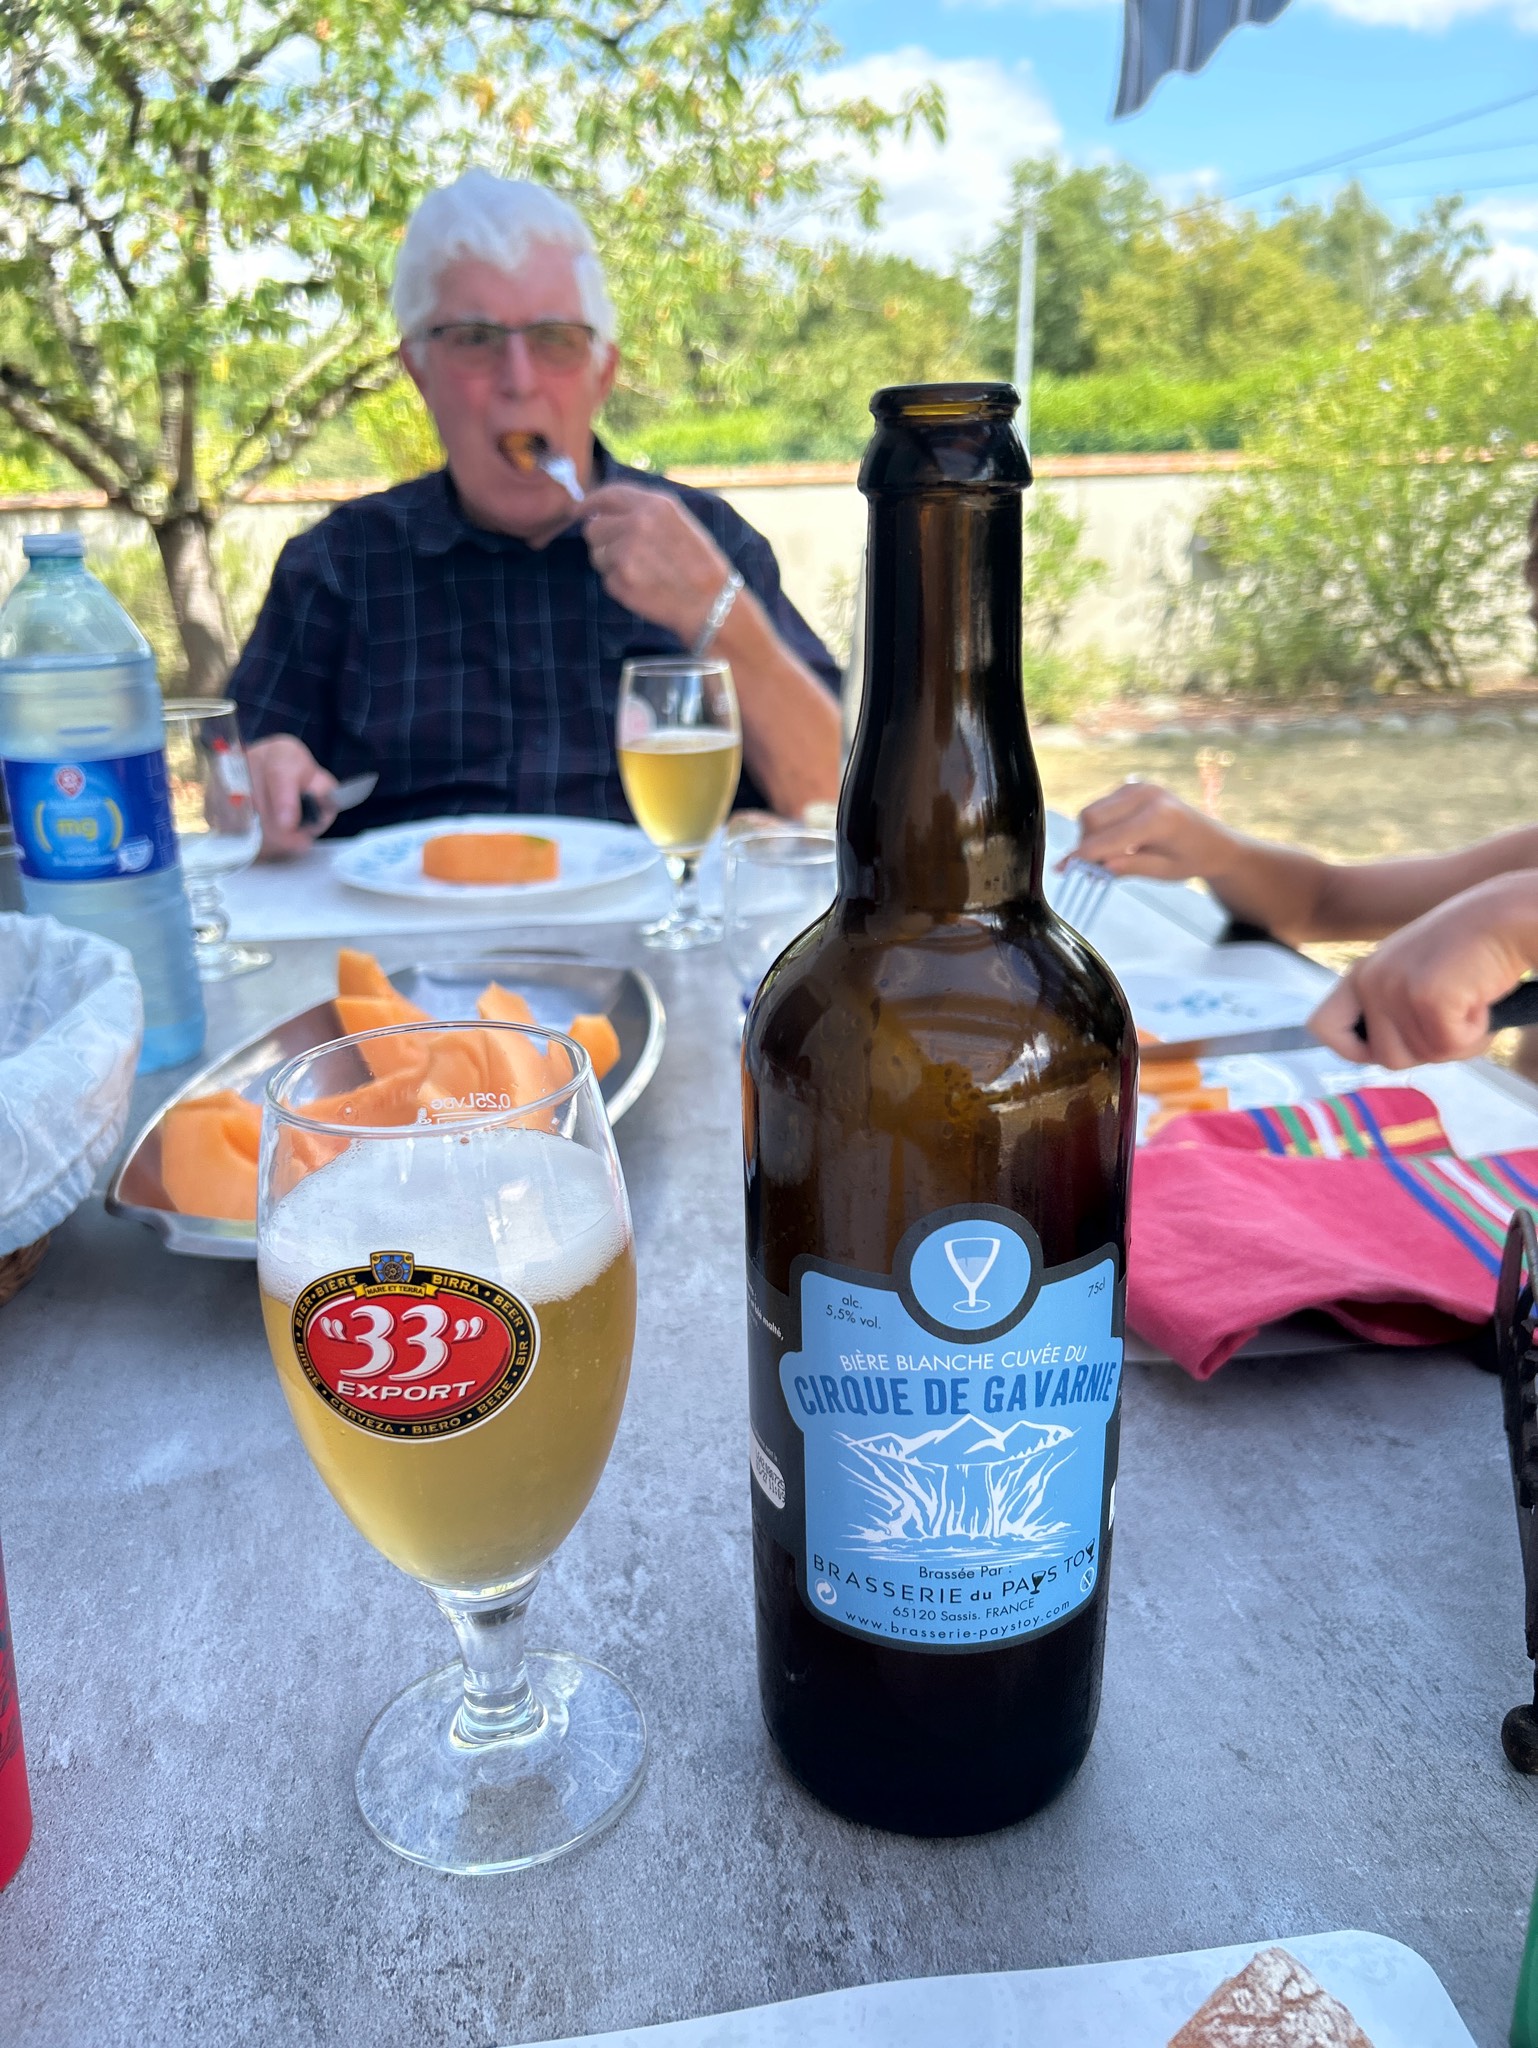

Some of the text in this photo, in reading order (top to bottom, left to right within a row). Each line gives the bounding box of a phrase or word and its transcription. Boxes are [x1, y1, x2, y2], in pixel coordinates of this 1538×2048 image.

[57, 817, 97, 841] mg
[315, 1275, 358, 1296] BIÈRE
[367, 1287, 387, 1295] MARE
[399, 1286, 424, 1295] TERRA
[432, 1275, 479, 1294] BIRRA
[1088, 1278, 1106, 1297] 75cl
[296, 1298, 313, 1326] BIER
[493, 1295, 523, 1326] BEER
[842, 1295, 862, 1309] alc.
[826, 1304, 882, 1329] 5,5% vol.
[516, 1341, 528, 1366] BIR
[840, 1343, 1087, 1371] BIÈRE BLANCHE CUVÉE DU
[337, 1381, 476, 1400] EXPORT
[477, 1381, 512, 1414] BERE
[794, 1362, 1116, 1416] CIRQUE DE GAVARNIE
[330, 1397, 394, 1433] CERVEZA
[412, 1418, 461, 1433] BIERO
[812, 1538, 1096, 1604] BRASSERIE du PAYS TOY
[919, 1565, 974, 1579] Brassée
[846, 1601, 1070, 1640] www.brasserie-paystoy.com
[893, 1598, 1035, 1622] 65120 Sassis. FRANCE
